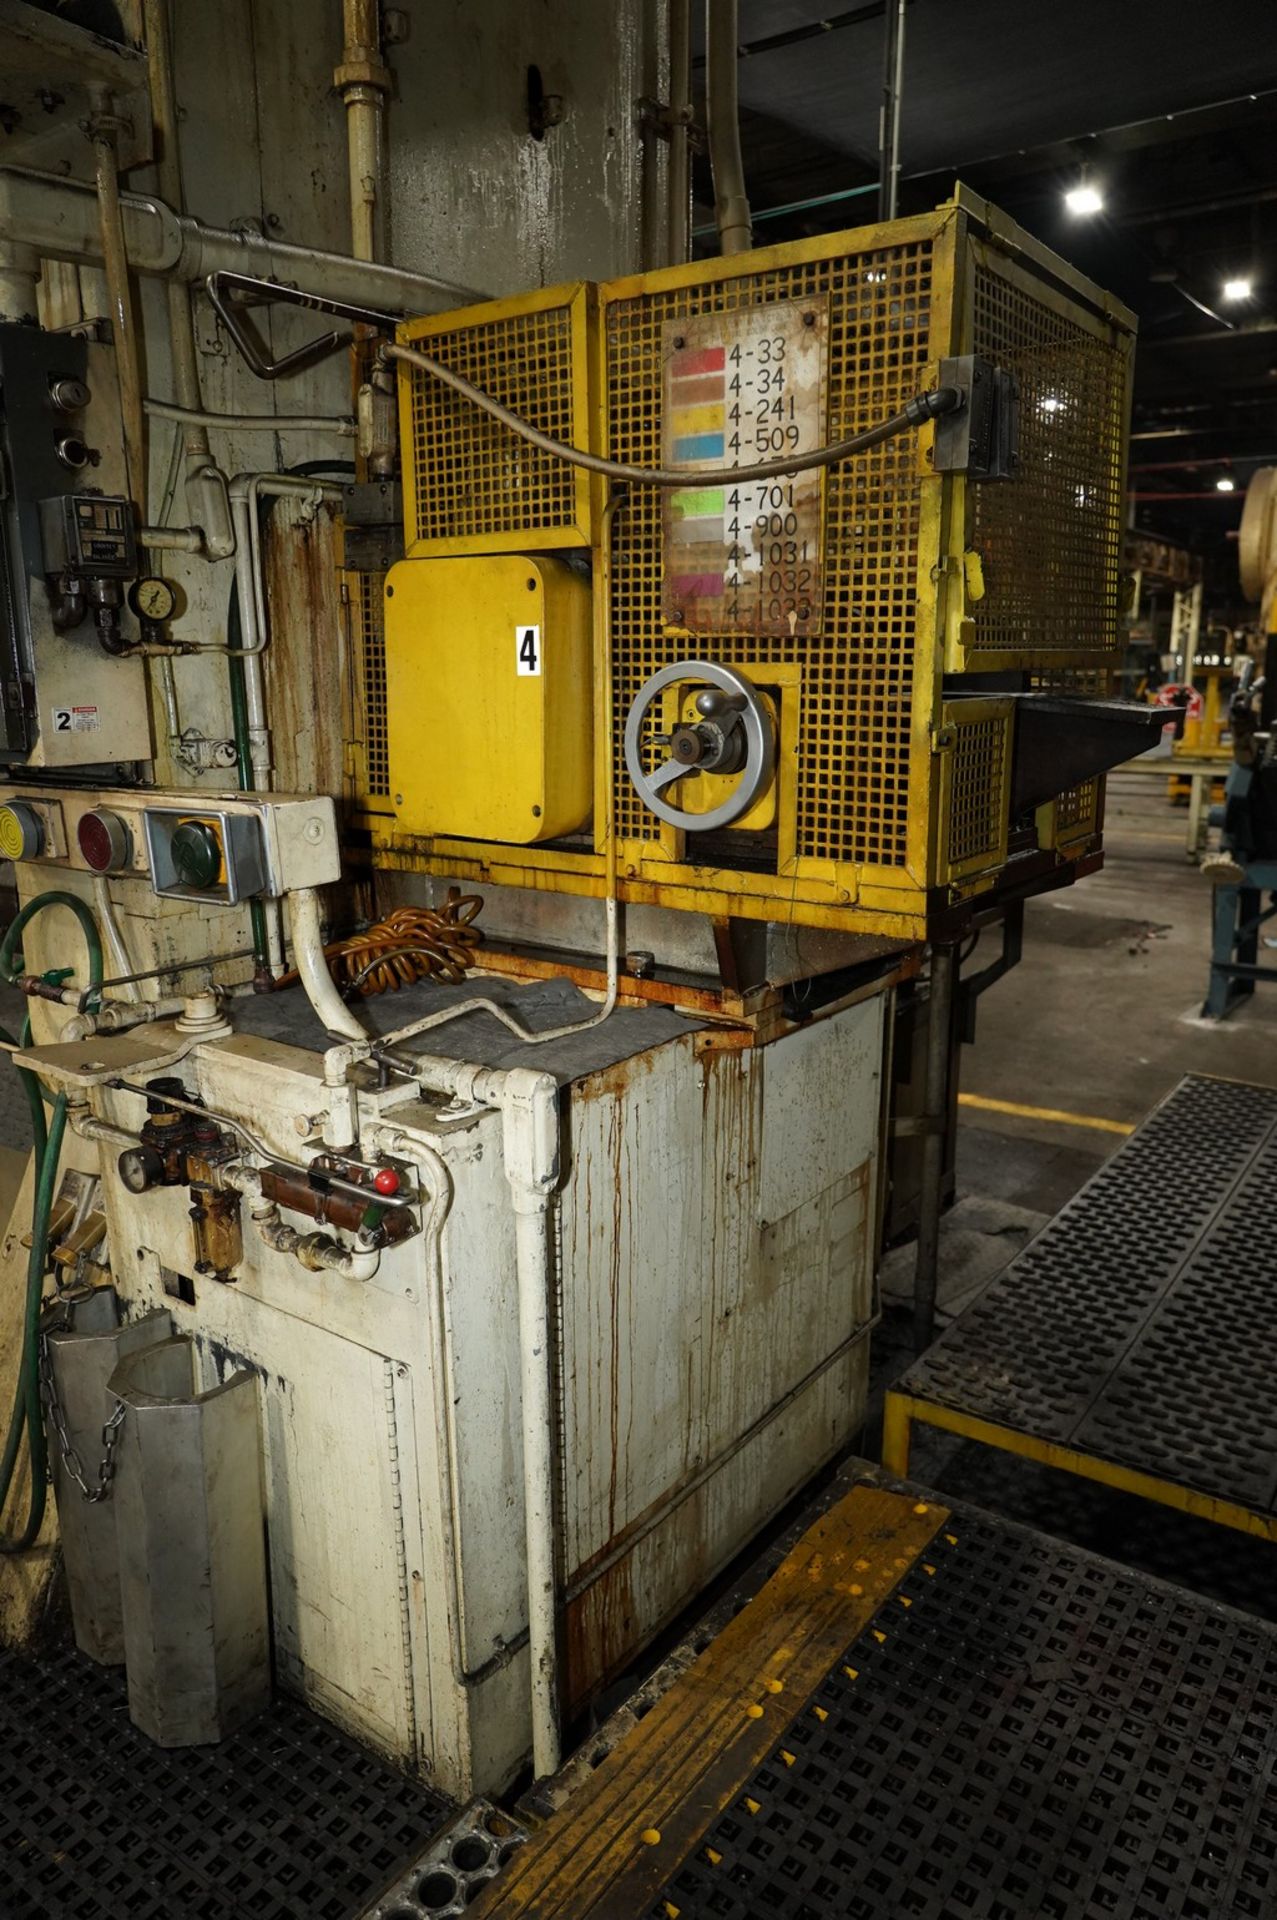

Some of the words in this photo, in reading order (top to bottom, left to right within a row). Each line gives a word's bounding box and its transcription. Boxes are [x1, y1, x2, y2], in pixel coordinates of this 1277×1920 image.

[729, 337, 786, 368] 4-33
[729, 366, 785, 398] 4-34
[728, 395, 794, 427] 4-241
[728, 425, 799, 455] 4-509
[728, 484, 793, 512] 4-701
[728, 513, 797, 540] 4-900
[728, 540, 808, 567] 4-1031
[728, 569, 811, 595] 4-1032
[520, 630, 537, 671] 4
[57, 712, 71, 730] 2
